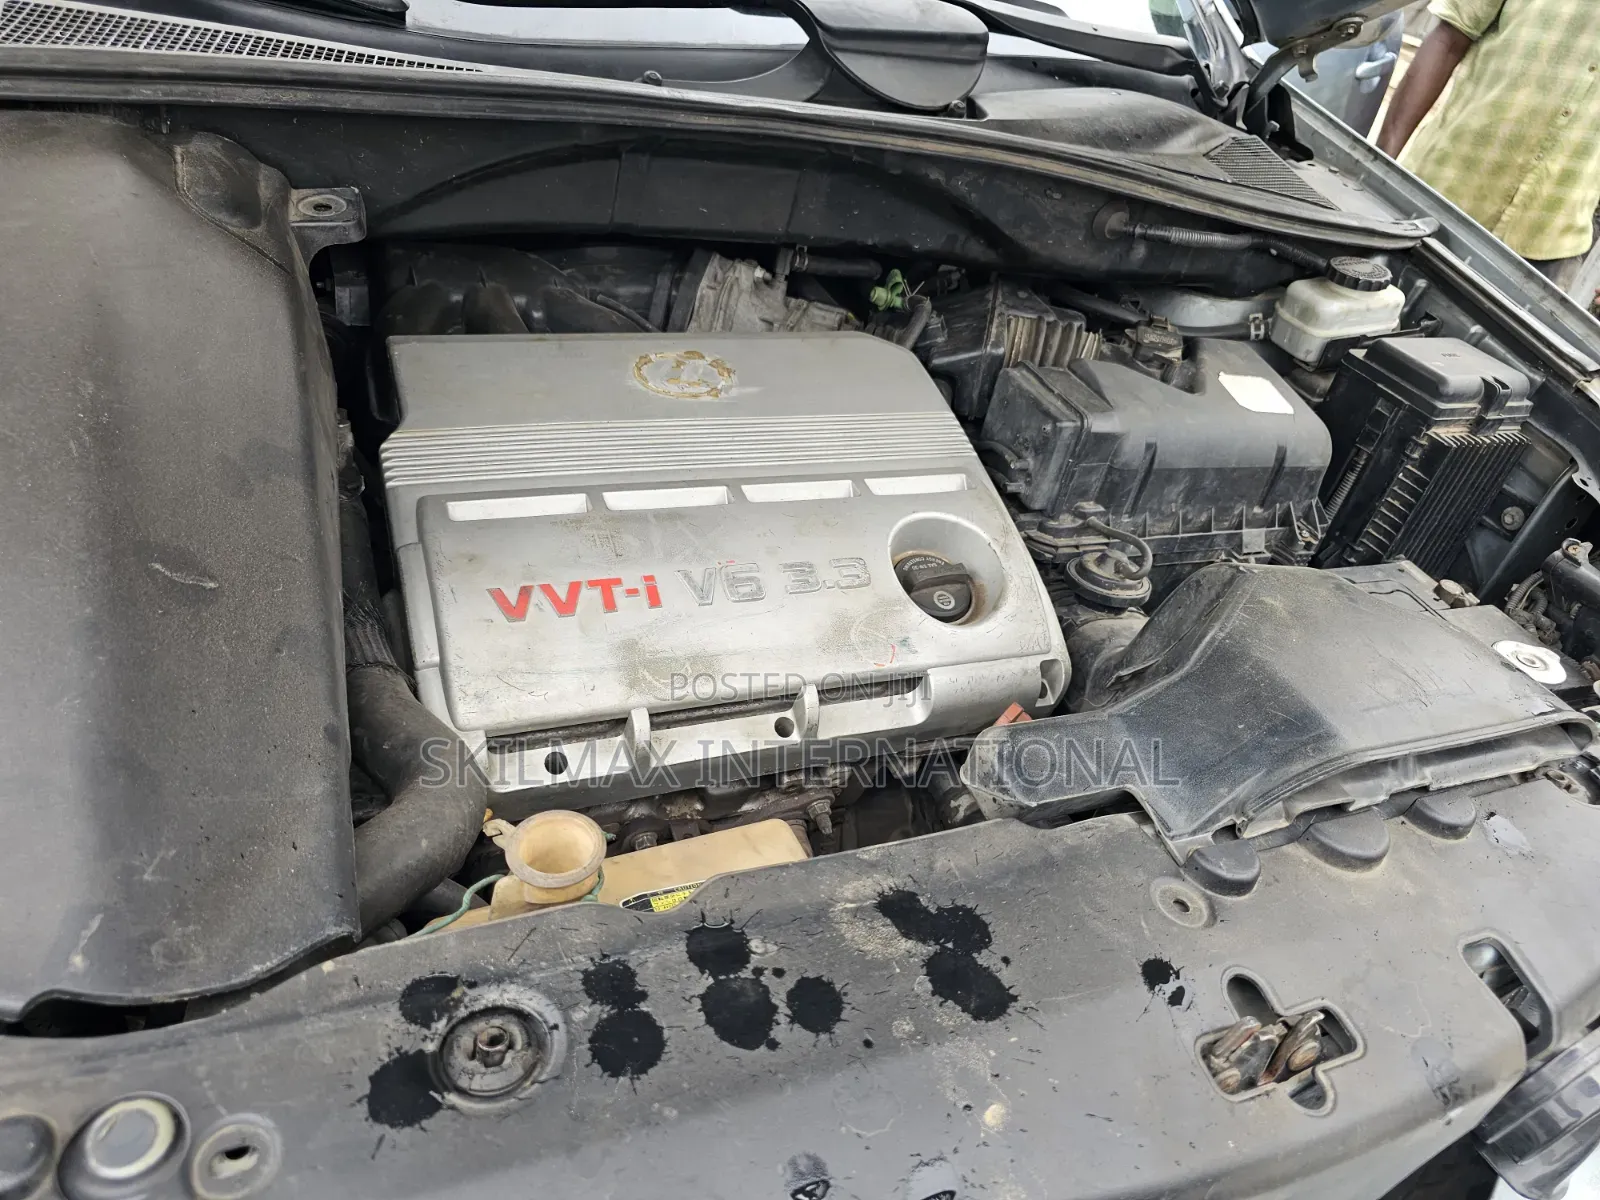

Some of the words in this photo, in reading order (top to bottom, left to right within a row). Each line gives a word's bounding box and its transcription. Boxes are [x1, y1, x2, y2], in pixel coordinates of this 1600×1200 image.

[486, 574, 662, 623] VVT-i
[674, 562, 767, 606] V6
[778, 557, 872, 595] 3.3
